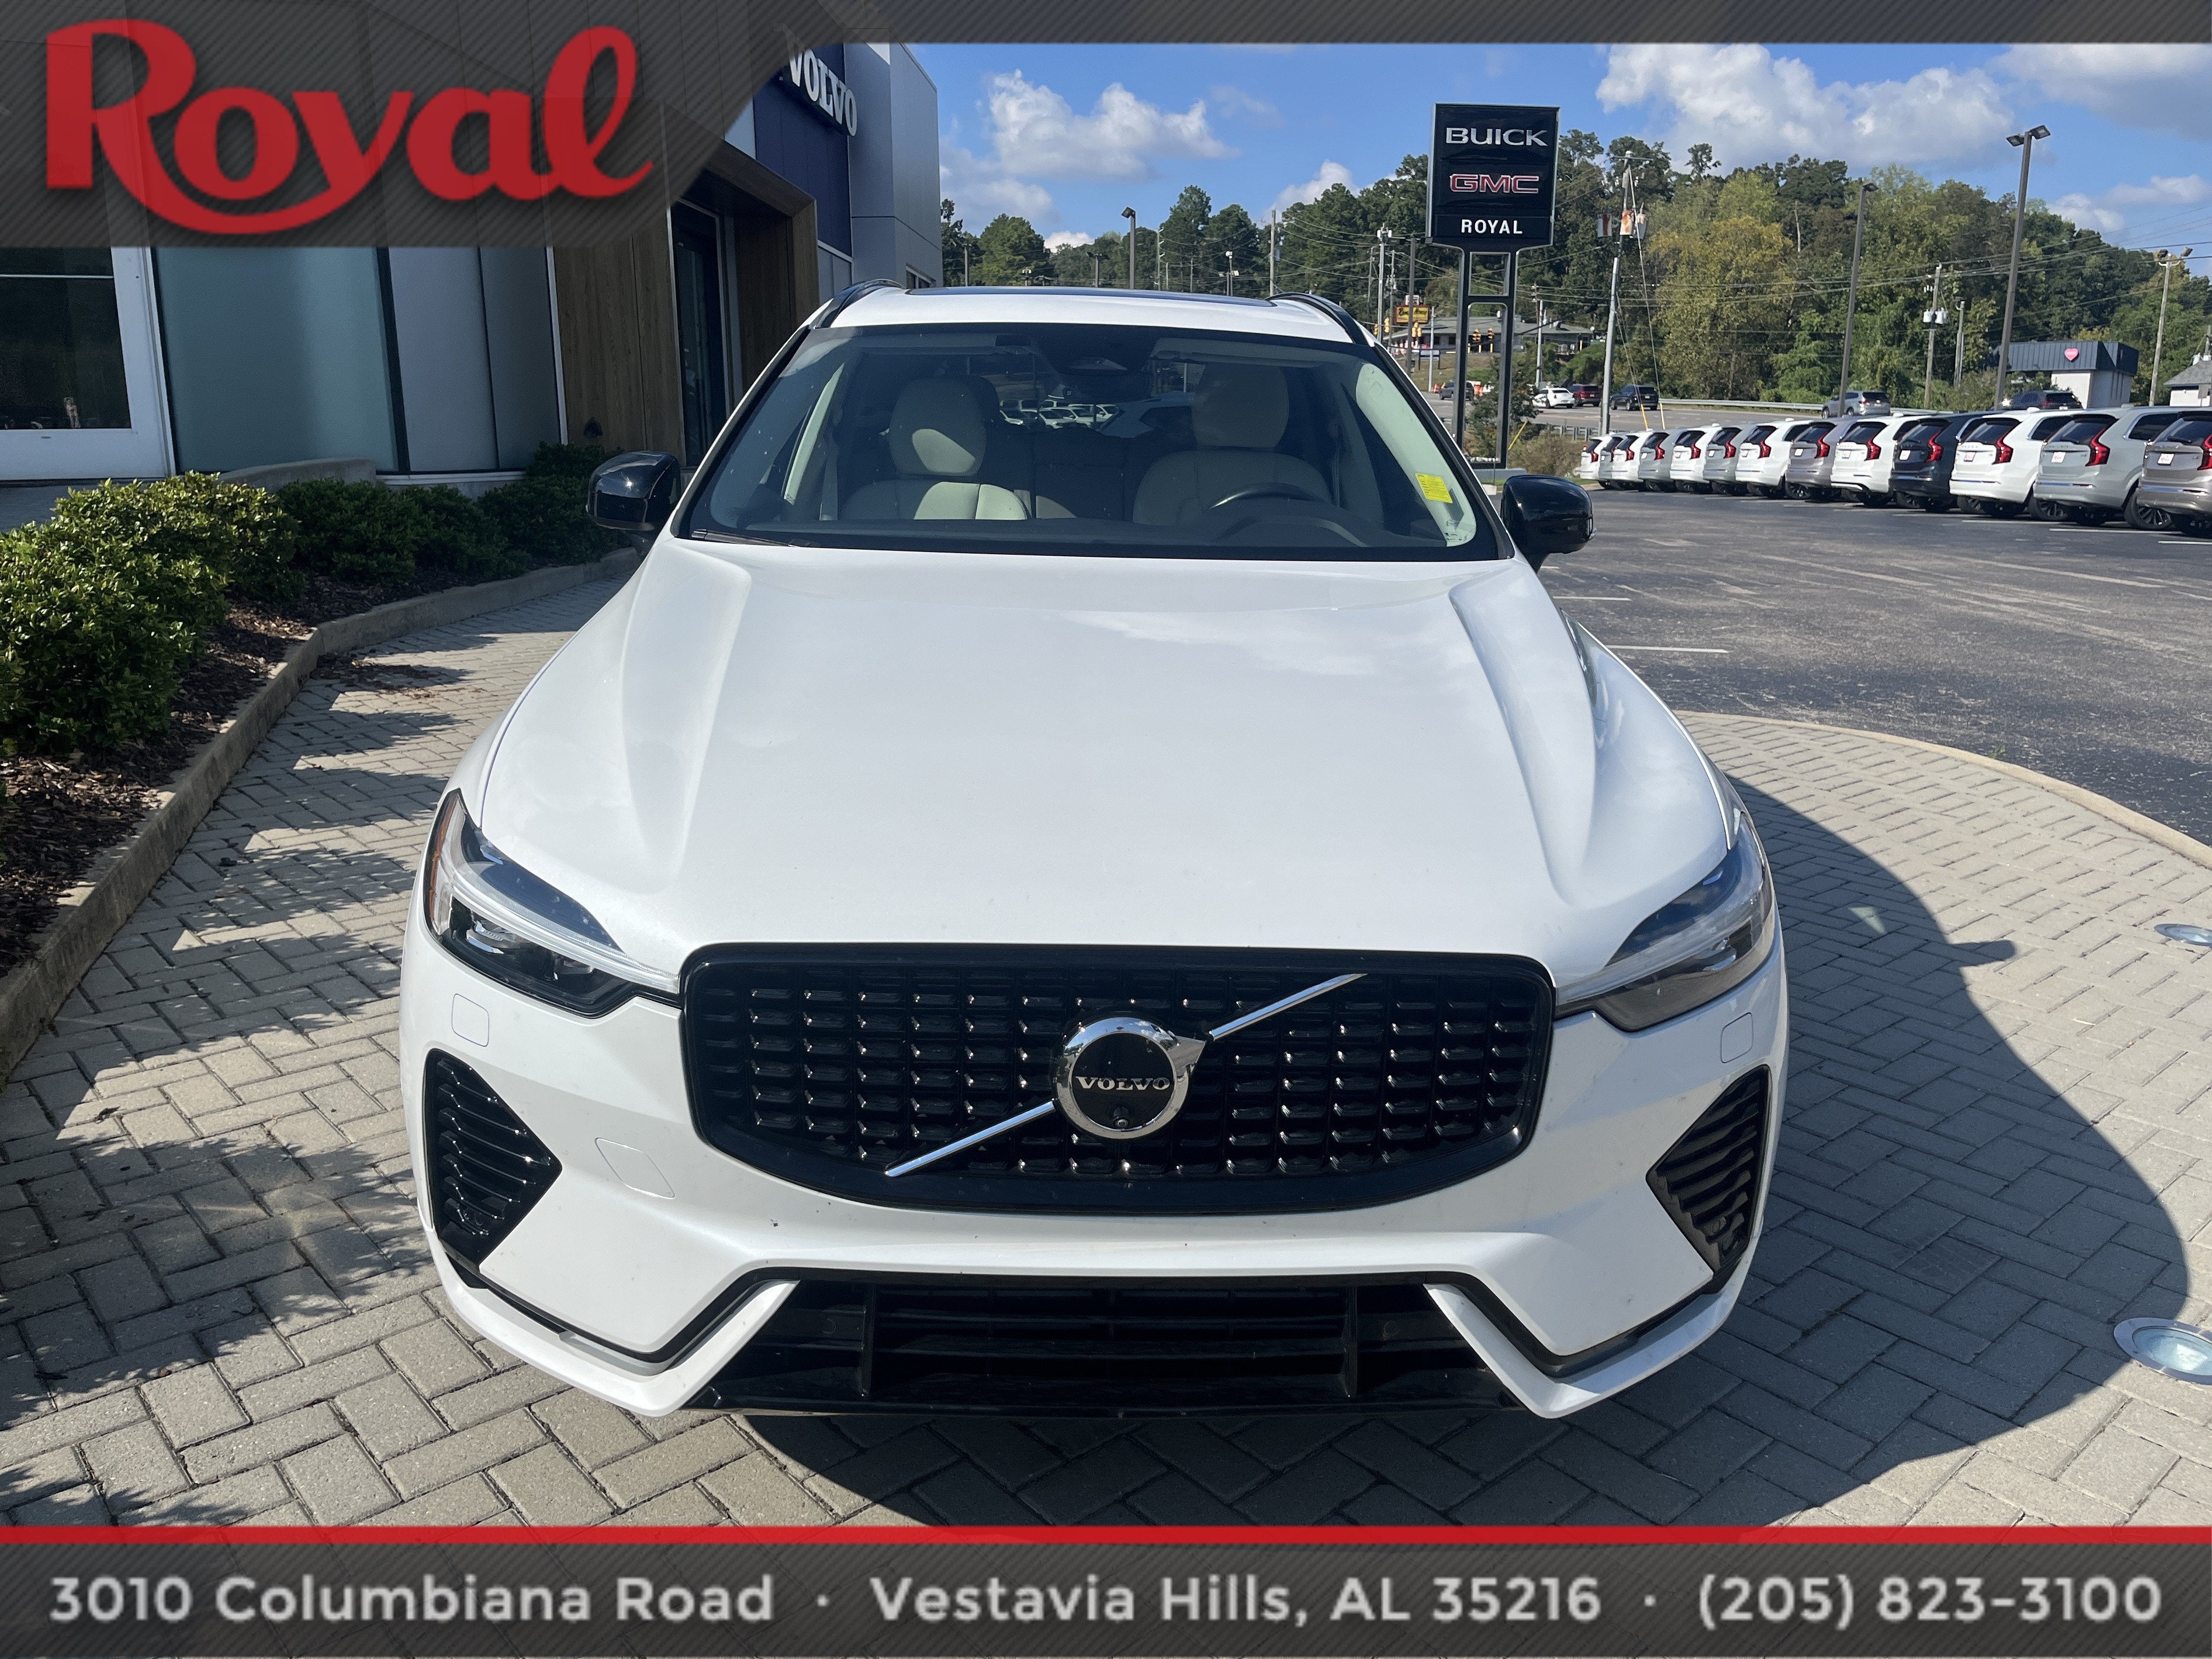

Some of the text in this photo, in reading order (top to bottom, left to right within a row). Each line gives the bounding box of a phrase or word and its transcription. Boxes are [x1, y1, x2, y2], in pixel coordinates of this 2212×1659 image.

[781, 25, 857, 137] VOLVO
[1446, 127, 1548, 146] BUICK
[1449, 173, 1539, 194] GMC
[1462, 219, 1523, 234] ROYAL
[1076, 1076, 1170, 1090] VOLVO
